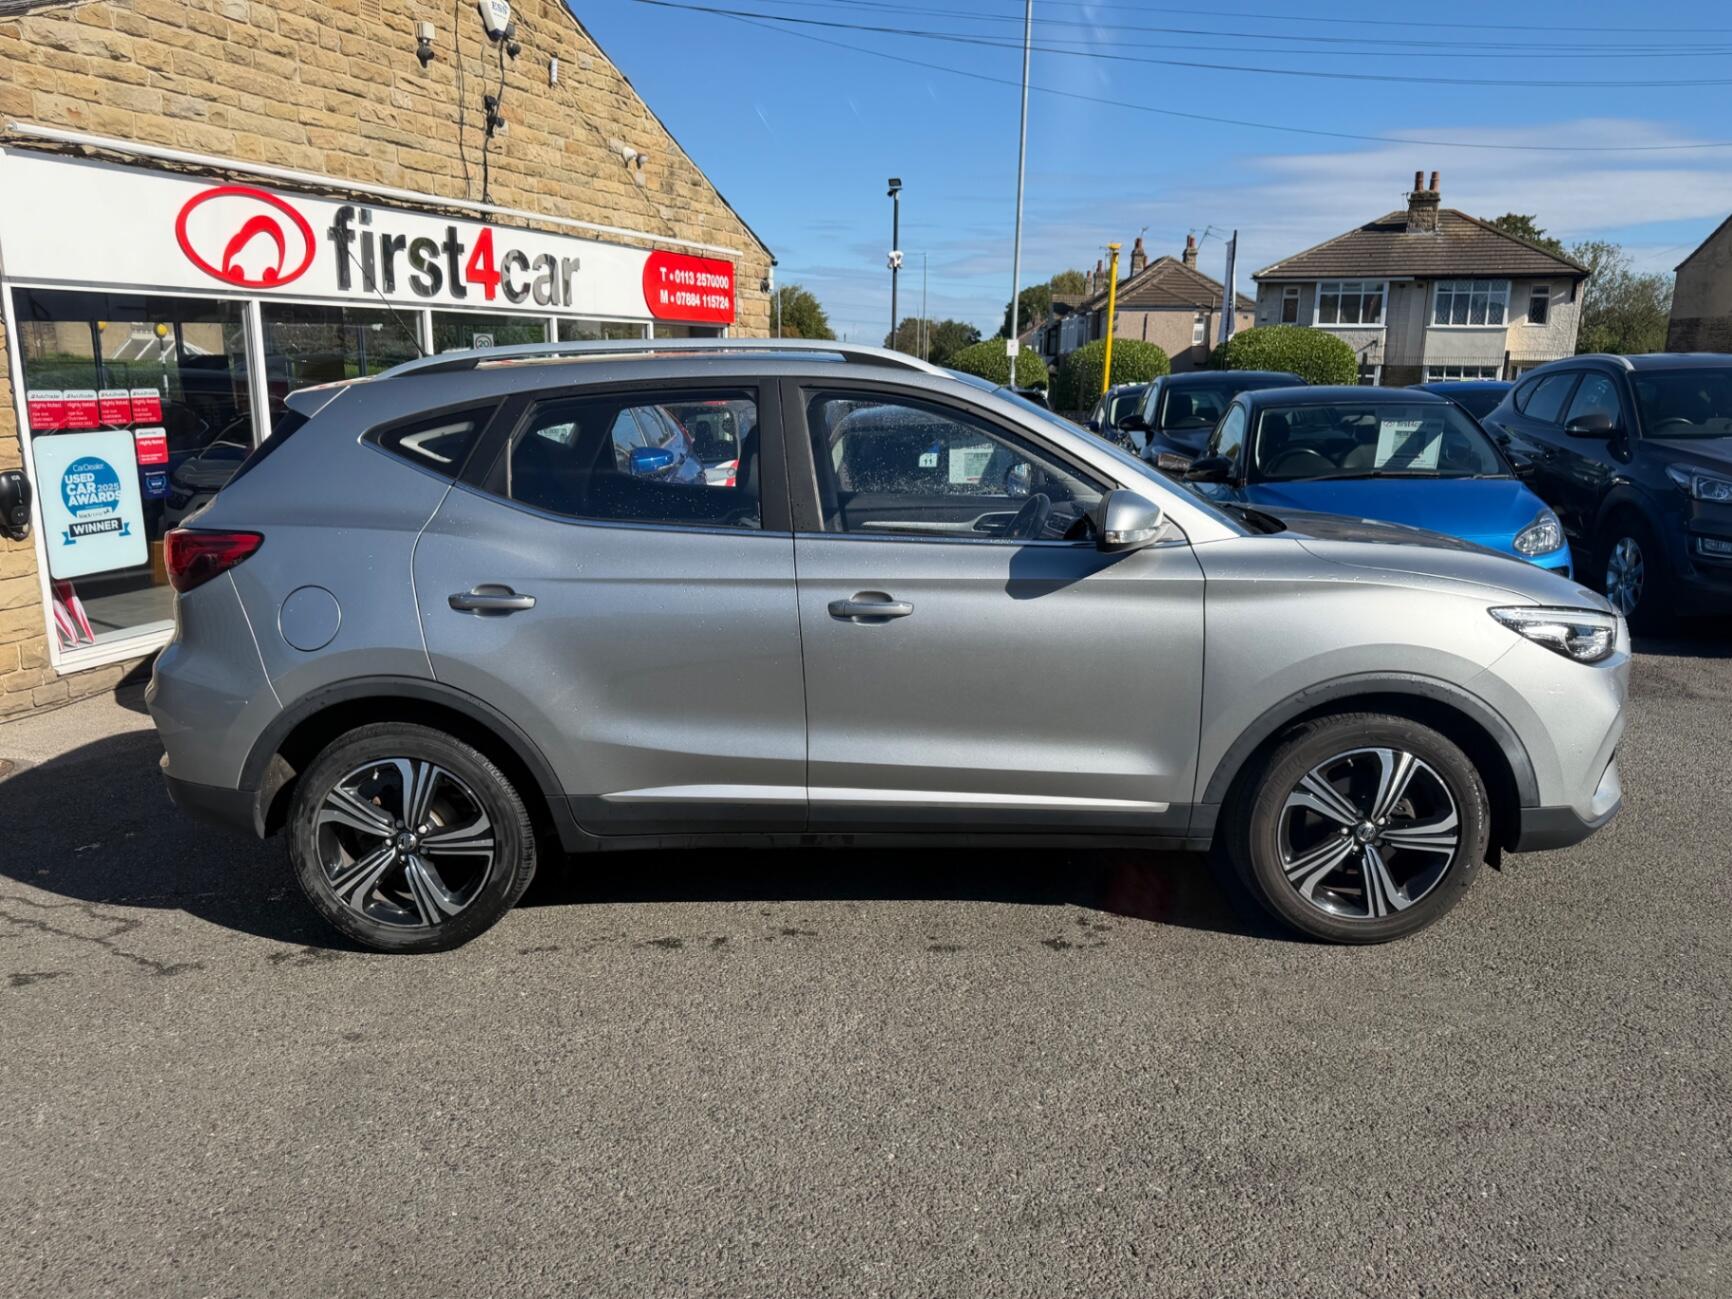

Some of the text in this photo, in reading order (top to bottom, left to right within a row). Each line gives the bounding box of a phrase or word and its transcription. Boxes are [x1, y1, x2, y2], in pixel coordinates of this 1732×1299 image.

[327, 205, 580, 307] first4car
[660, 267, 729, 289] T 0113 2570000
[660, 289, 729, 309] M 07884 115724
[478, 339, 490, 348] 20
[64, 473, 95, 484] USED
[66, 482, 120, 496] CAR 2025
[68, 490, 121, 507] AWARDS
[73, 519, 119, 535] WINNER
